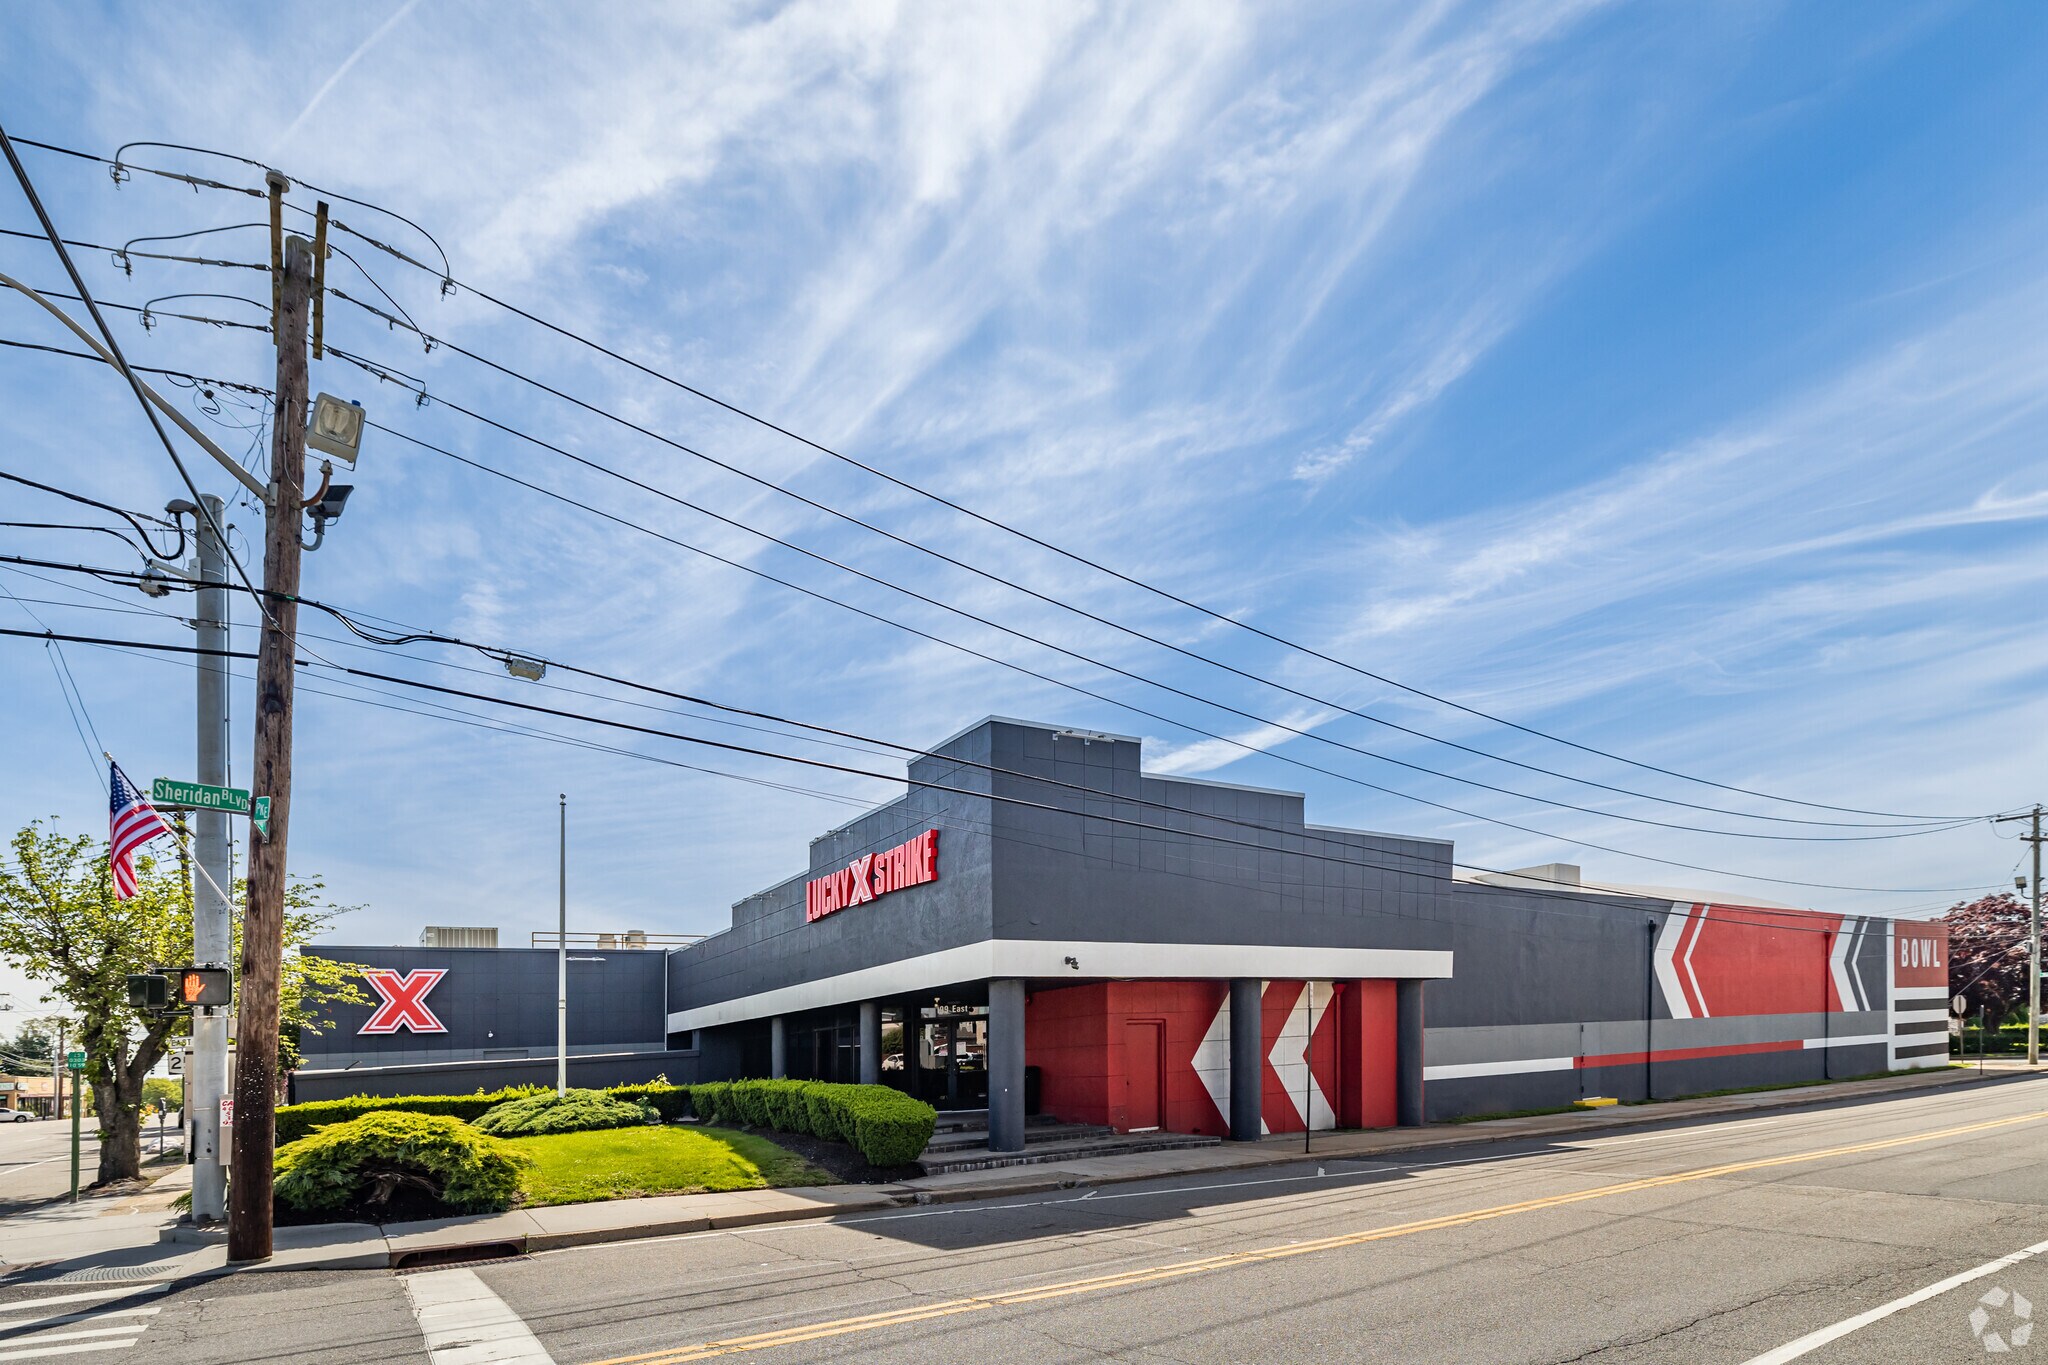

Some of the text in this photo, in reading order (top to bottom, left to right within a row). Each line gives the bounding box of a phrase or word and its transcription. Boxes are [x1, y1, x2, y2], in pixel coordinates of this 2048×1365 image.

[155, 781, 248, 810] Sheridan BLVD
[806, 829, 939, 923] LUCKY X STRIKE
[1901, 938, 1941, 968] BOWL
[357, 968, 450, 1035] X
[952, 1004, 968, 1013] East
[171, 1056, 186, 1070] 2
